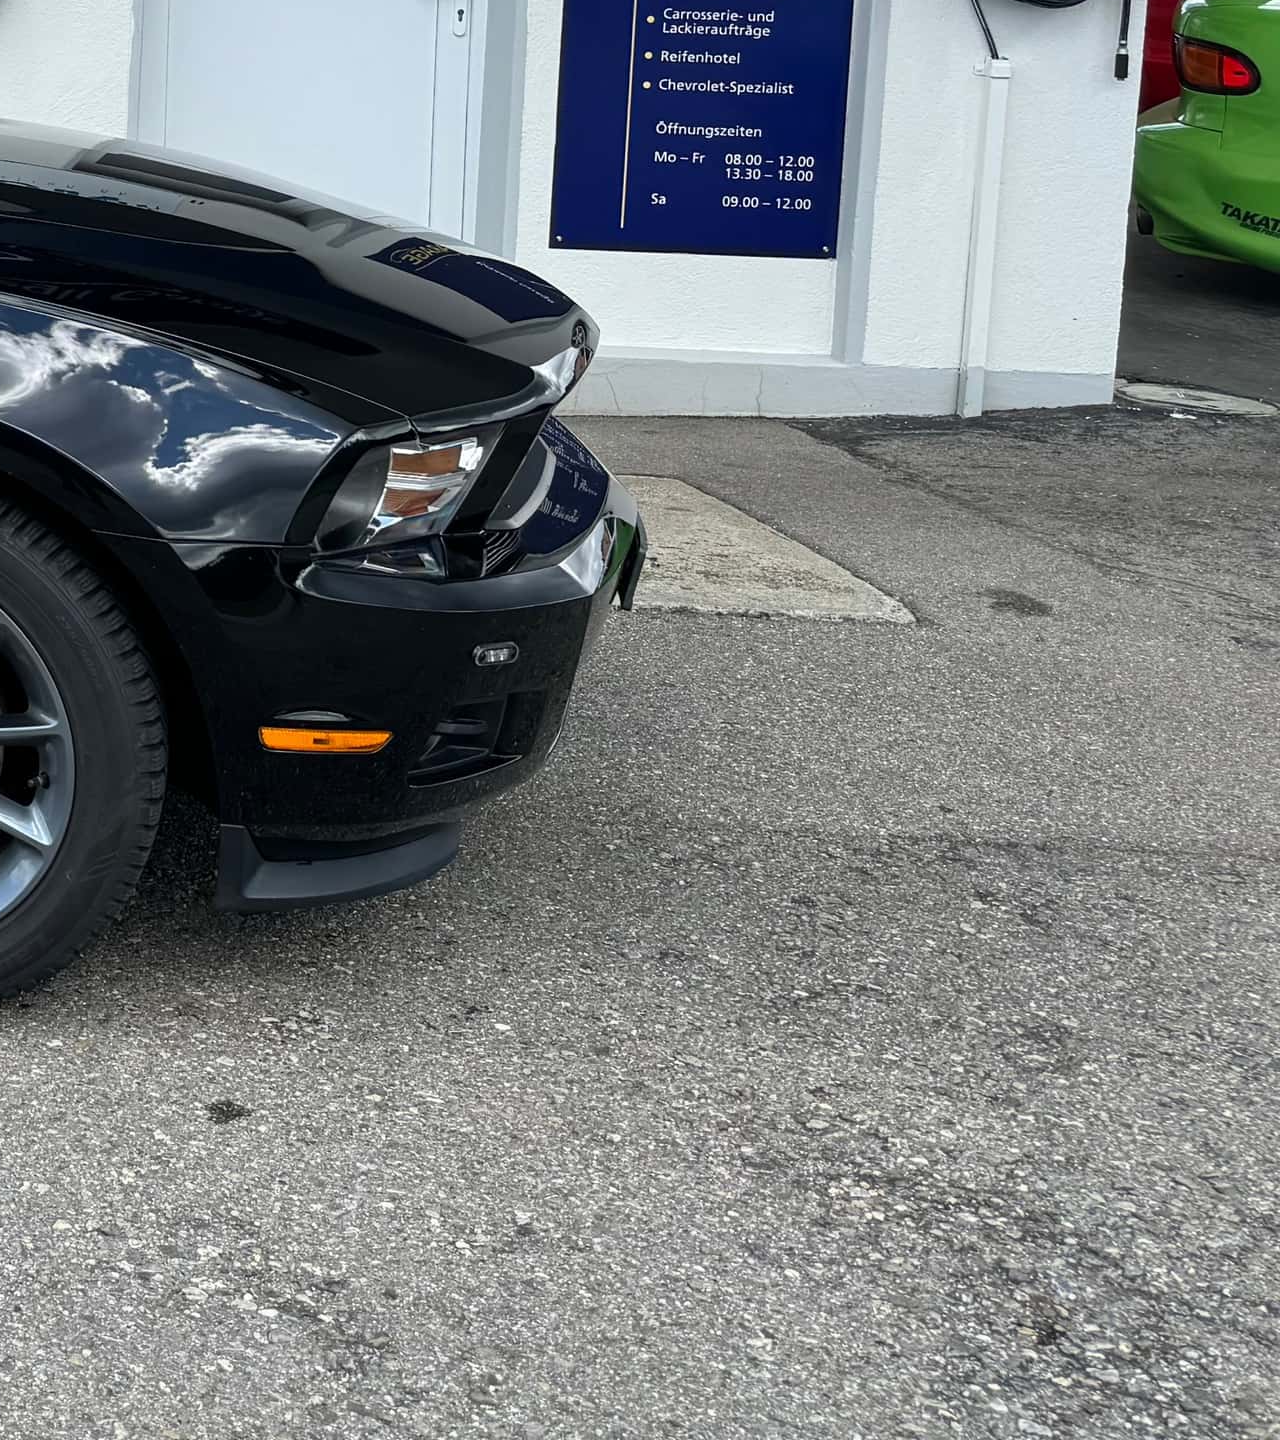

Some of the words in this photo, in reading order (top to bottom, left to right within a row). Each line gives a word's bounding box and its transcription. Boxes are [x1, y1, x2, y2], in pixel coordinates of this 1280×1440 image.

[663, 9, 743, 22] Carrosserie-
[747, 10, 774, 23] und
[662, 23, 771, 39] Lackieraufträge
[660, 50, 741, 64] Reifenhotel
[658, 78, 794, 96] Chevrolet-Spezialist
[656, 120, 762, 139] Öffnungszeiten
[654, 151, 676, 164] Mo
[692, 152, 705, 164] Fr
[724, 153, 762, 166] 08.00
[778, 155, 814, 168] 12.00
[725, 168, 761, 180] 13.30
[778, 169, 813, 182] 18.00
[651, 193, 666, 205] Sa
[722, 195, 759, 208] 09.00
[775, 197, 811, 210] 12.00
[1221, 201, 1280, 232] TAKAT
